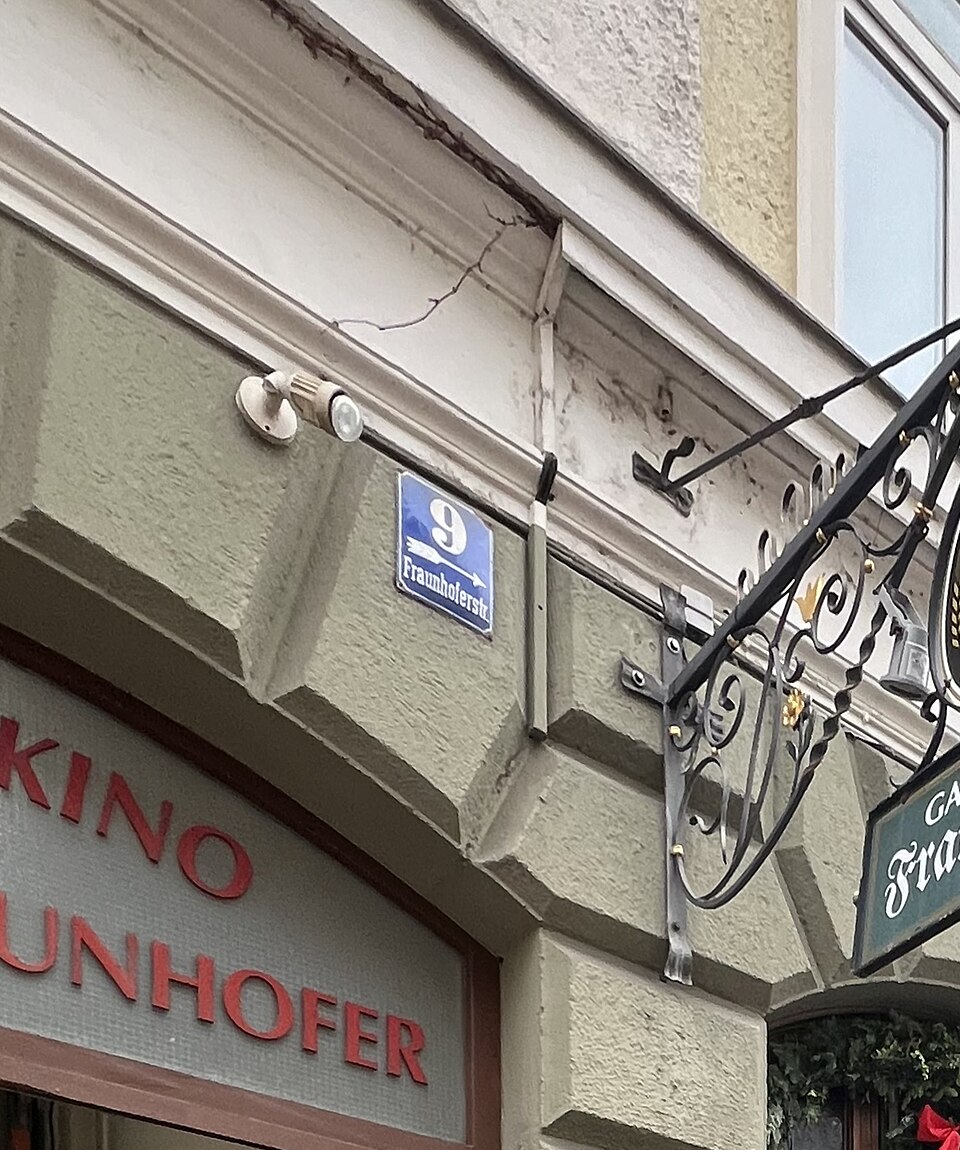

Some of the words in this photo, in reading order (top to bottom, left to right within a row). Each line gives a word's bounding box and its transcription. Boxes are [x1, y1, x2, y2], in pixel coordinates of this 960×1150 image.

[430, 499, 466, 555] 9
[403, 555, 489, 623] Fraunhoferstr.
[0, 714, 253, 898] KINO
